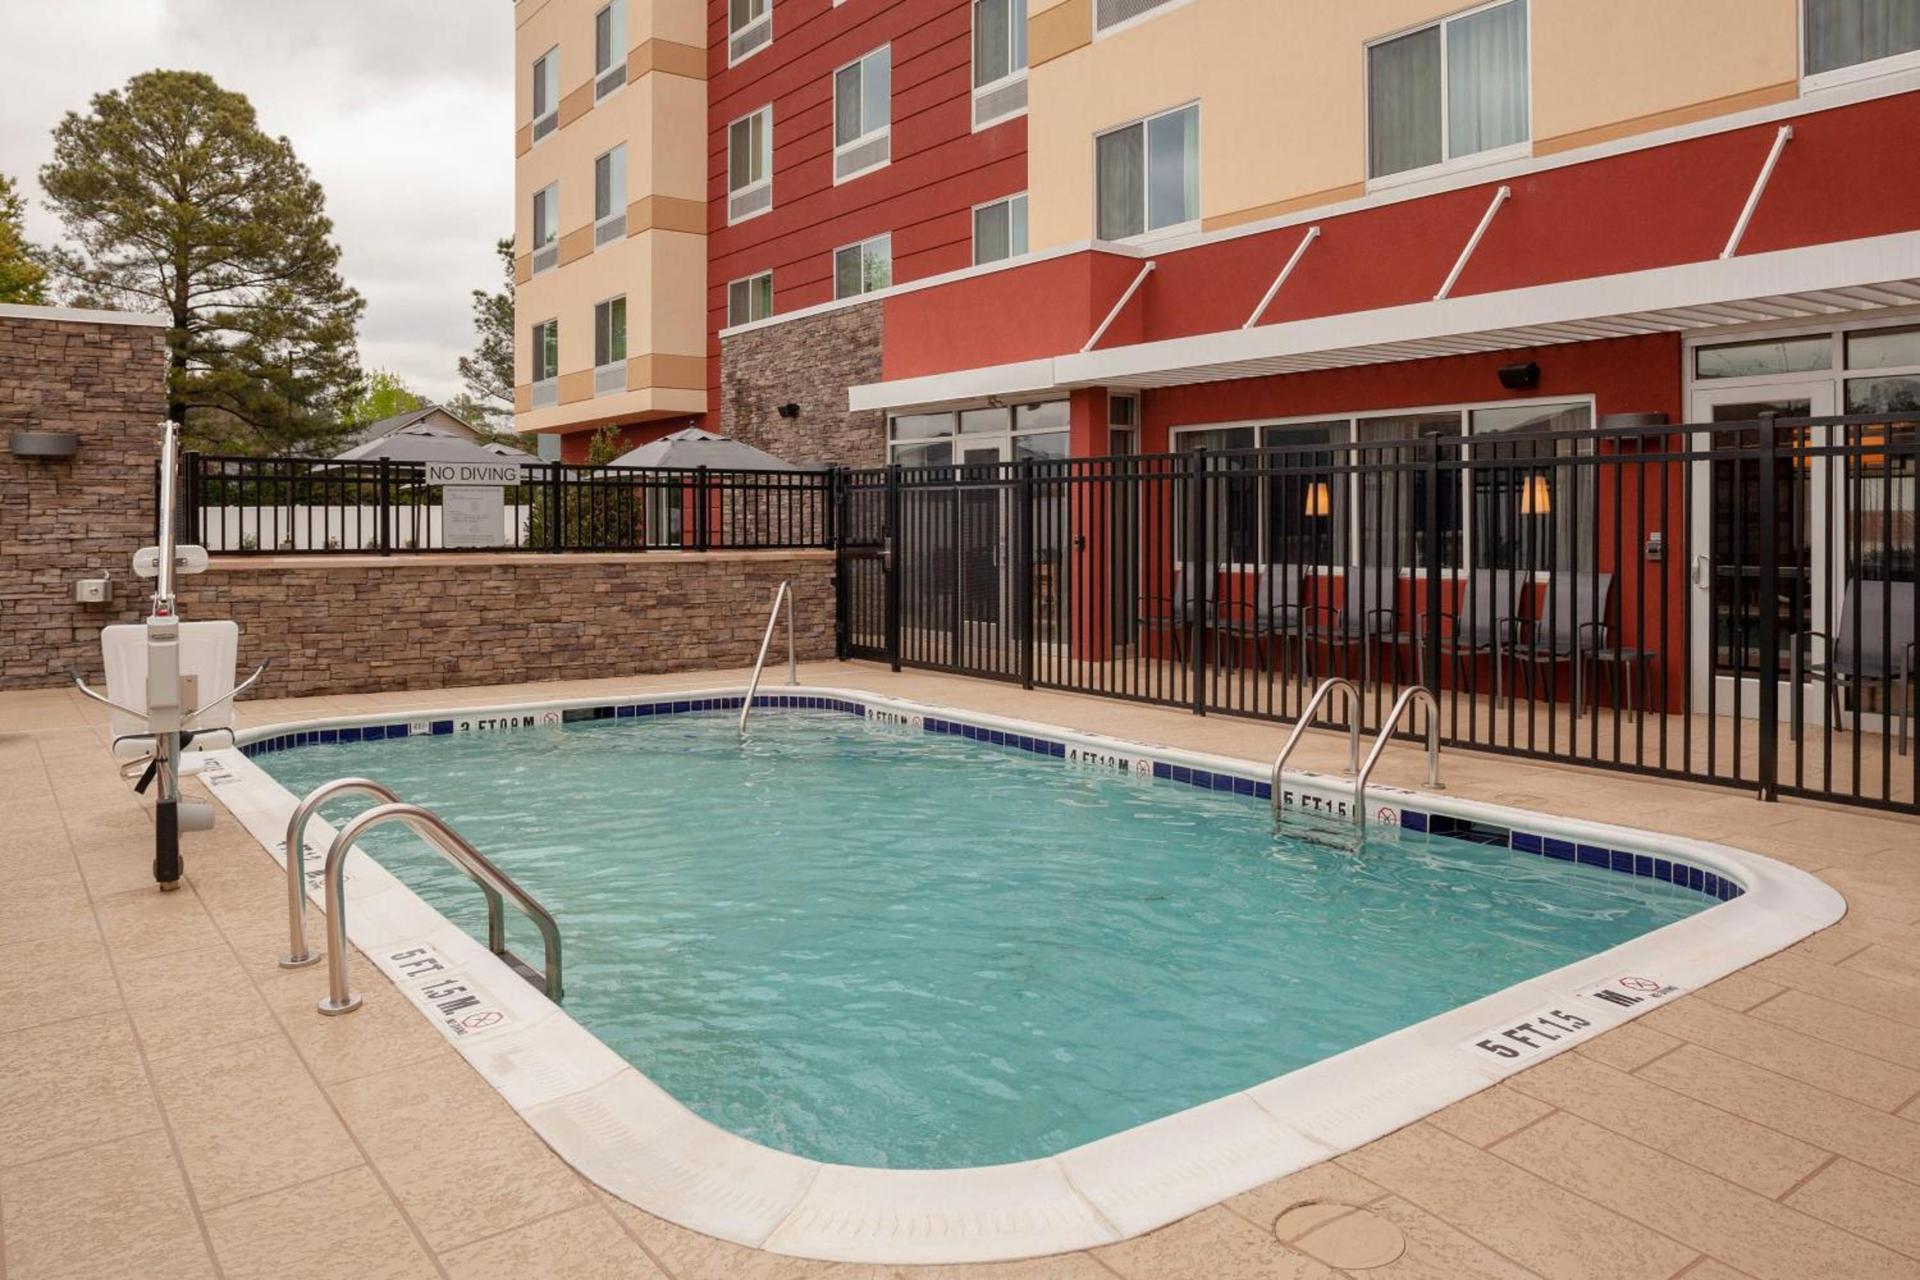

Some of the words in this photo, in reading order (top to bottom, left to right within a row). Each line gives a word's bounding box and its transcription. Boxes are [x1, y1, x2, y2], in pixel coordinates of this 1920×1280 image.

[430, 466, 455, 480] NO
[460, 466, 516, 481] DIVING
[390, 948, 427, 961] 5
[1476, 1039, 1520, 1058] 5
